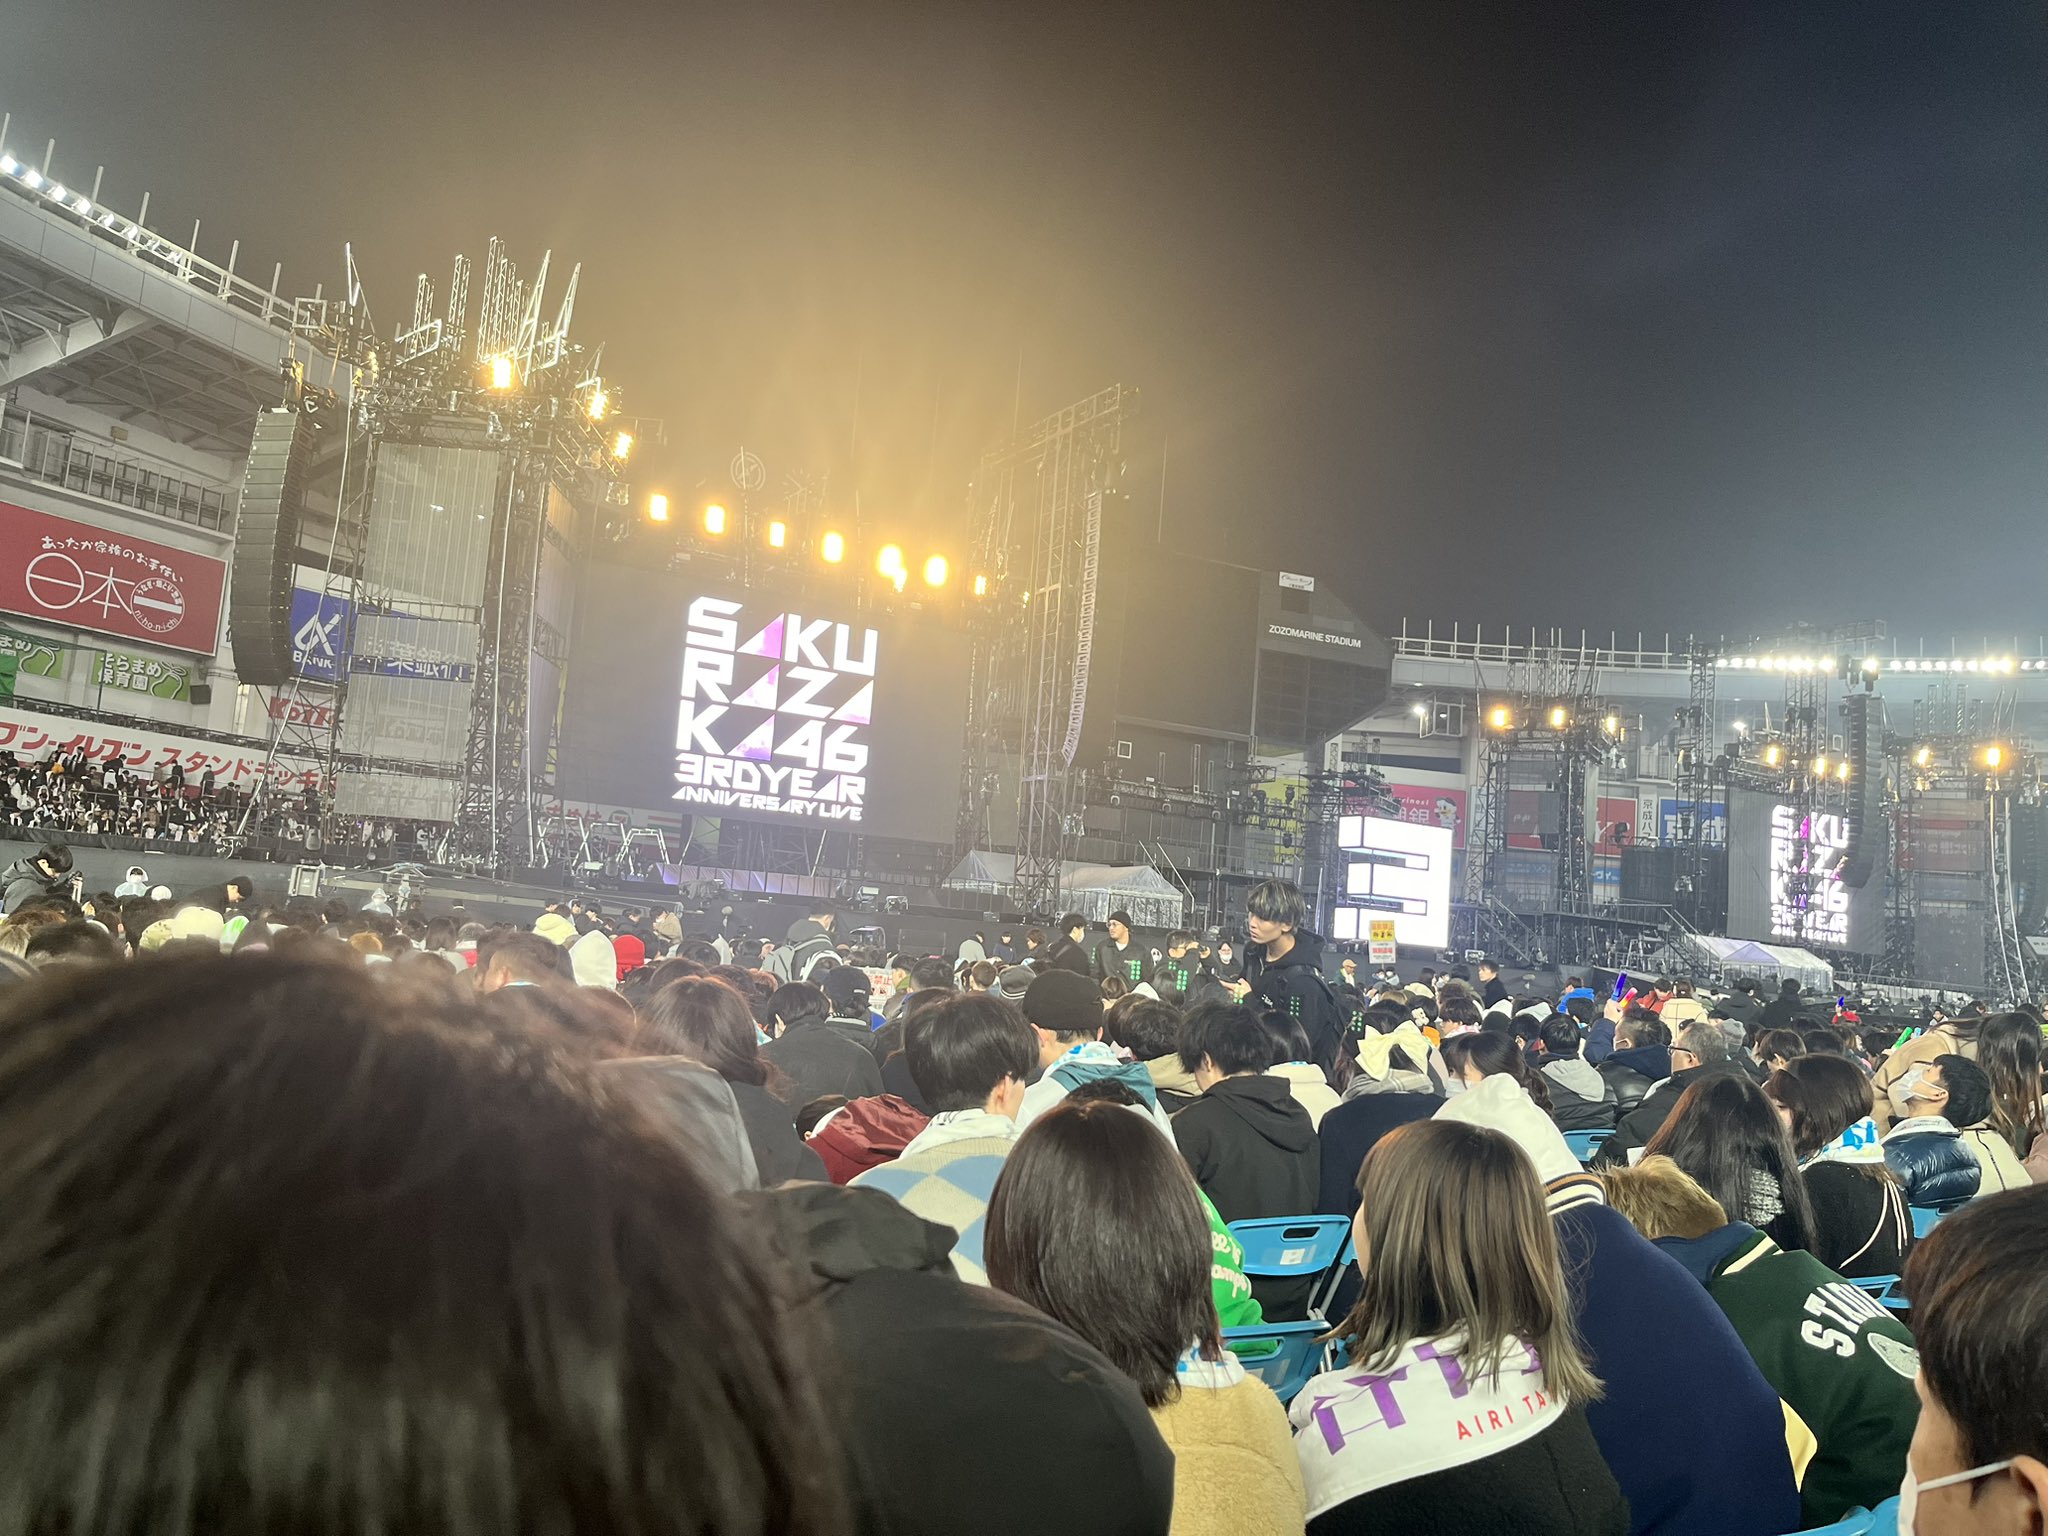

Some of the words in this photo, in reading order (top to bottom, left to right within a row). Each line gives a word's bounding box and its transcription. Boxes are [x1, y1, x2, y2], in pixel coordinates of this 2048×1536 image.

[686, 596, 878, 676] SAKU
[1324, 635, 1361, 649] STADIUM
[1456, 1405, 1514, 1440] AIRI
[1522, 1385, 1553, 1416] TA
